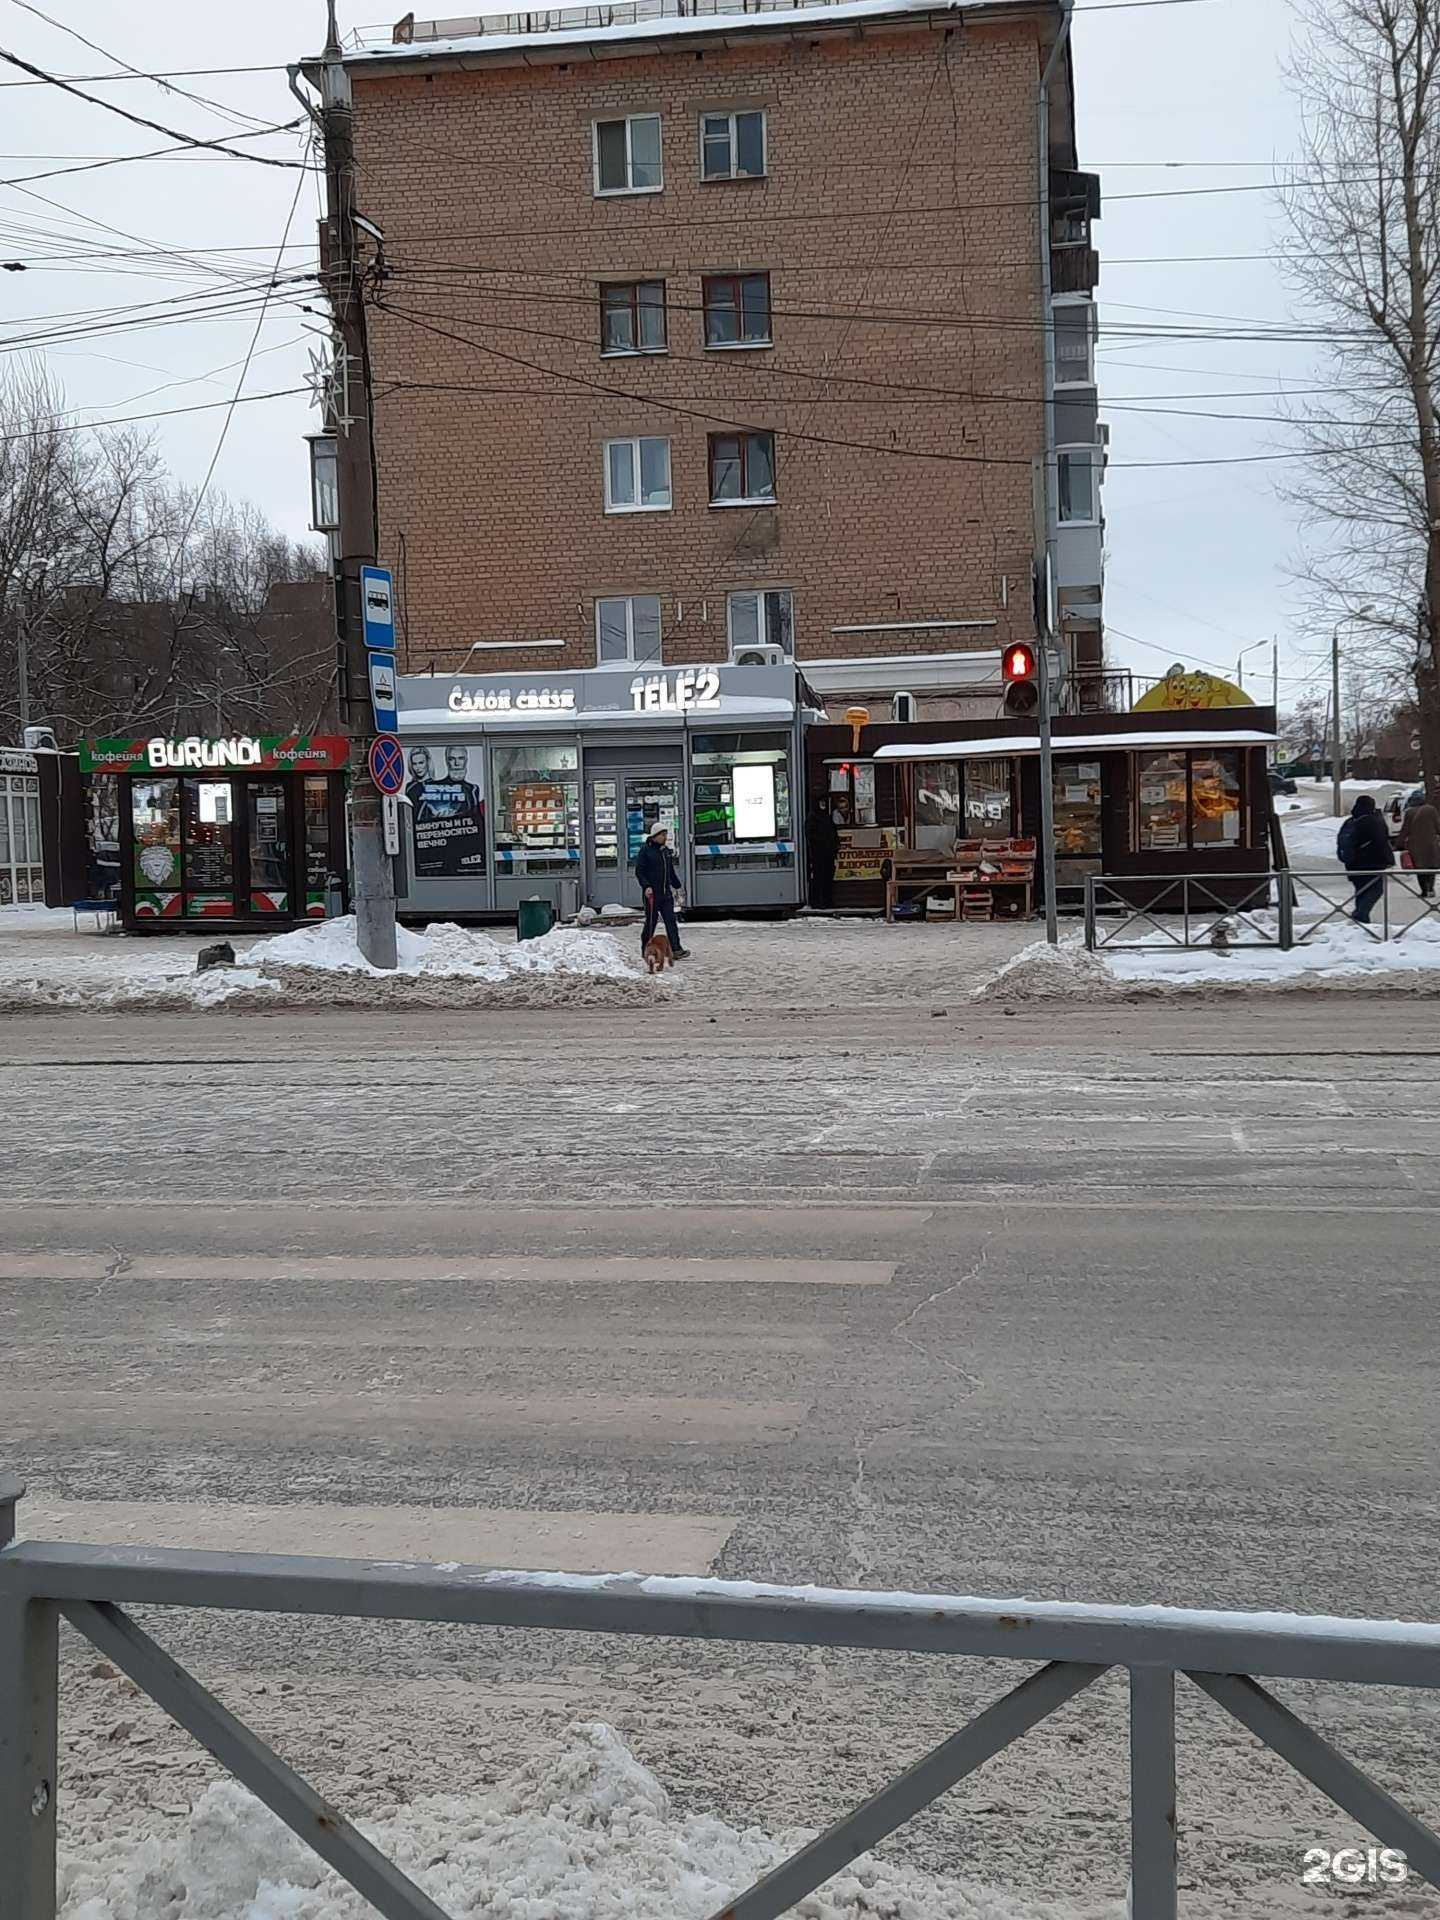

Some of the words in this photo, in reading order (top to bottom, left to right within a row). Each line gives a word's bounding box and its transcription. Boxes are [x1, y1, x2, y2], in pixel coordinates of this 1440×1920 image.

[630, 673, 721, 711] TELE2
[448, 691, 511, 711] Салон
[516, 693, 575, 709] связи
[91, 750, 144, 763] кофейня
[148, 739, 262, 768] BURUNDI
[272, 748, 327, 762] кофейня
[416, 819, 453, 831] МИНУТЫ
[454, 818, 461, 827] И
[463, 817, 473, 826] ГБ
[416, 825, 478, 840] ПЕРЕНОСЯТСЯ
[417, 838, 447, 849] ВЕЧНО
